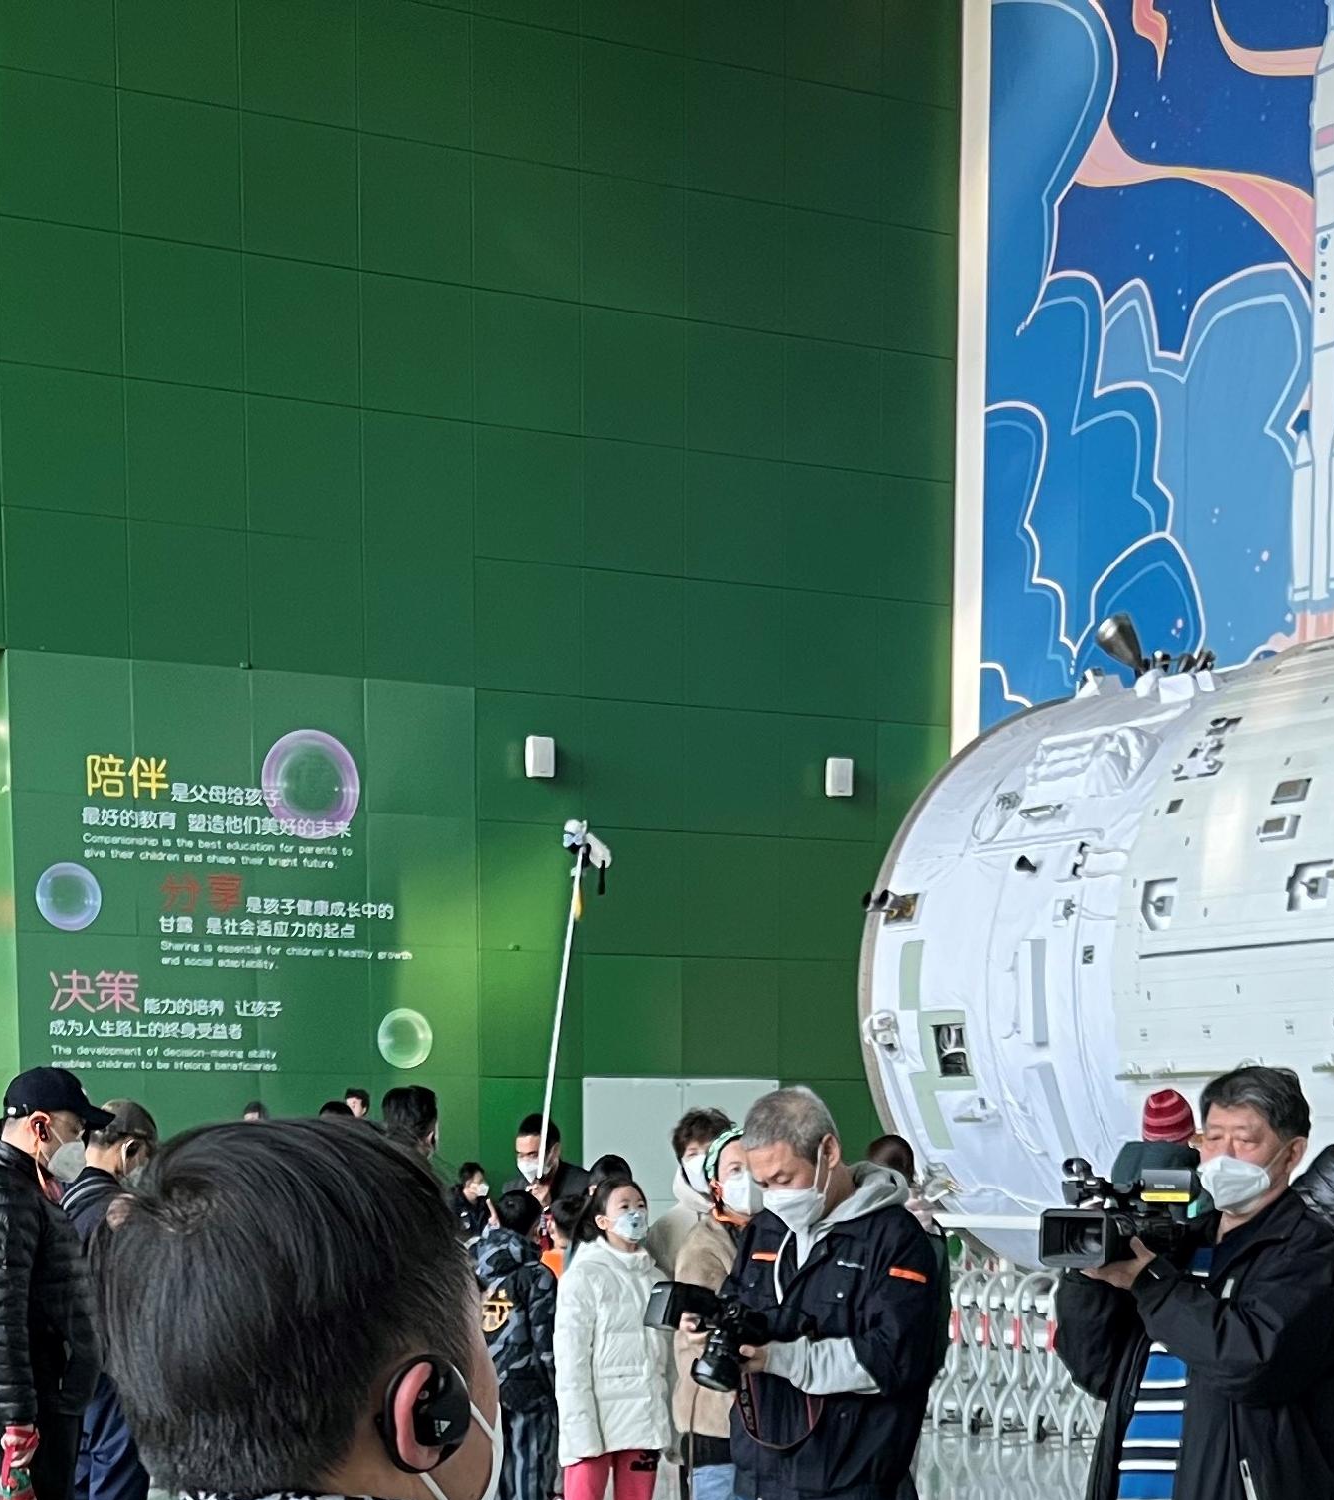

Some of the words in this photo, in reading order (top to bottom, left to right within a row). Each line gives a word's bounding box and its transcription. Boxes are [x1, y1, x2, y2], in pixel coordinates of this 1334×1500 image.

[86, 753, 169, 800] 陪伴
[170, 782, 283, 808] 是父母给孩子
[82, 806, 177, 830] 最好的教育
[187, 813, 352, 839] 塑造他们美好的未来
[139, 850, 180, 862] children
[176, 837, 194, 849] the
[197, 838, 222, 850] best
[226, 841, 275, 853] education
[279, 842, 295, 854] for
[341, 847, 354, 857] to
[245, 896, 395, 920] 是孩子健康成长中的
[205, 917, 356, 939] 是社会适应力的起点
[265, 944, 282, 956] for
[49, 969, 141, 1014] 决策
[143, 997, 225, 1017] 能力的培养
[234, 999, 284, 1018] 让孩子
[50, 1044, 73, 1056] The
[146, 1046, 159, 1057] of
[95, 1060, 137, 1069] children
[141, 1060, 153, 1070] to
